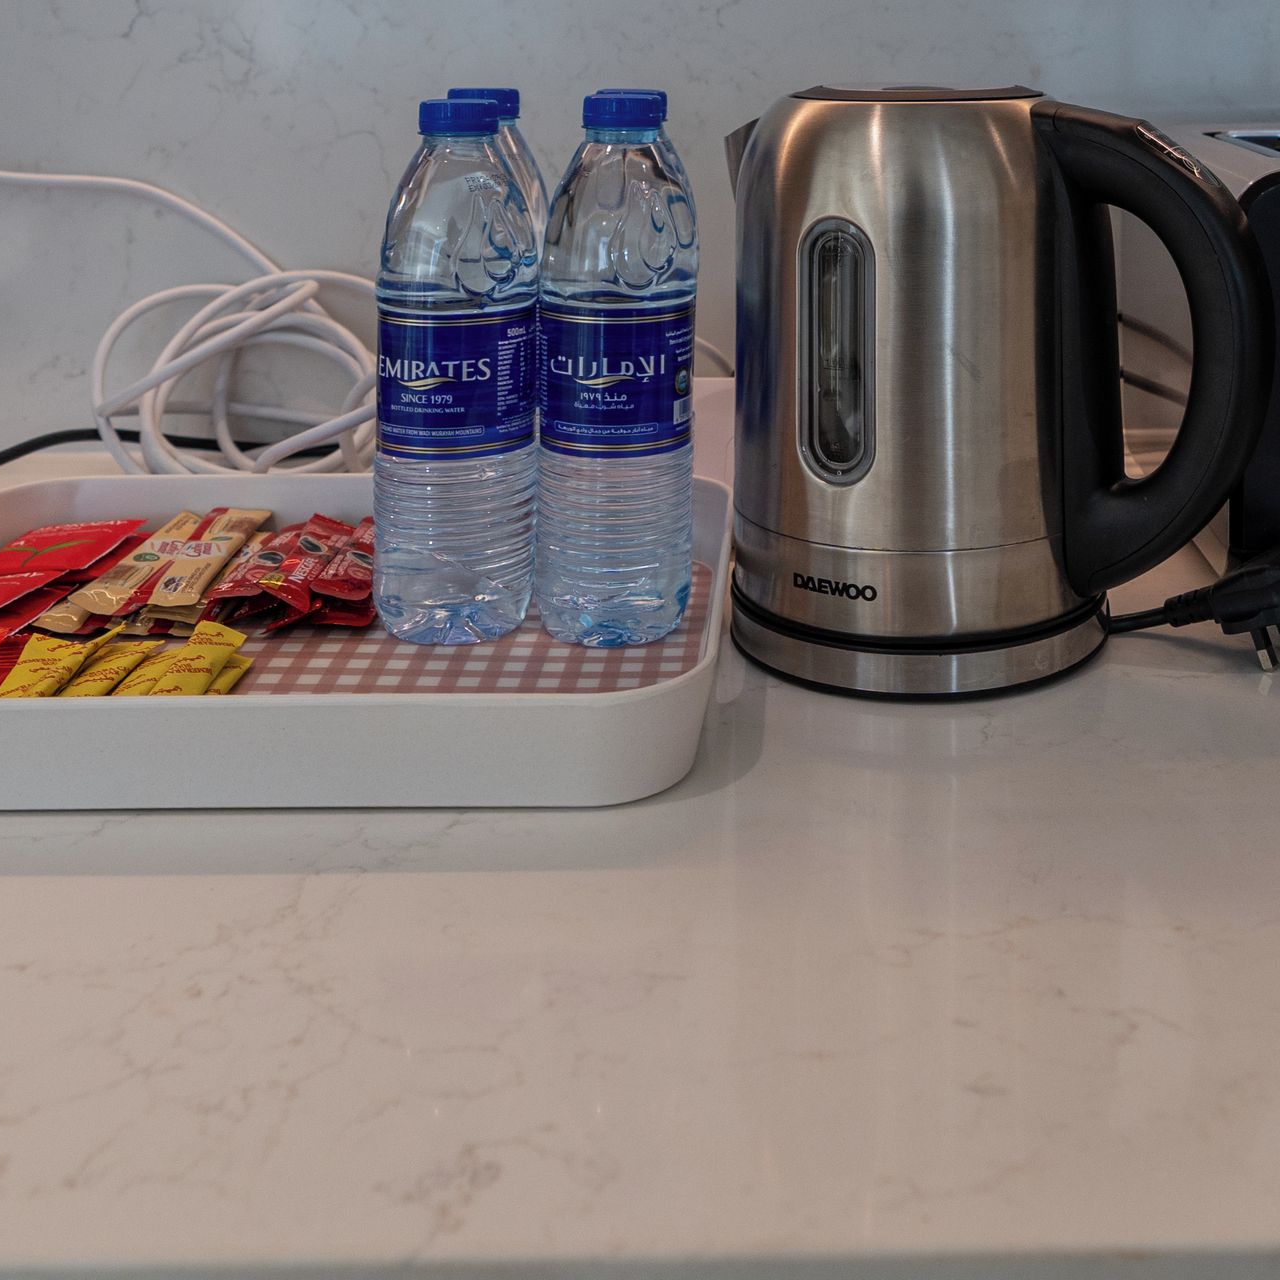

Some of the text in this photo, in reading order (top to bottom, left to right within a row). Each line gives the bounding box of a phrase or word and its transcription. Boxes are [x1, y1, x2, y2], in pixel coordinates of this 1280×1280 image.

[378, 354, 491, 382] EMIRATES
[551, 354, 665, 383] الإمارات
[400, 393, 453, 405] SINCE 1979
[580, 392, 627, 402] منذ ١٩٧٩
[391, 404, 414, 413] BOTTLED
[793, 572, 877, 602] DAEWOO
